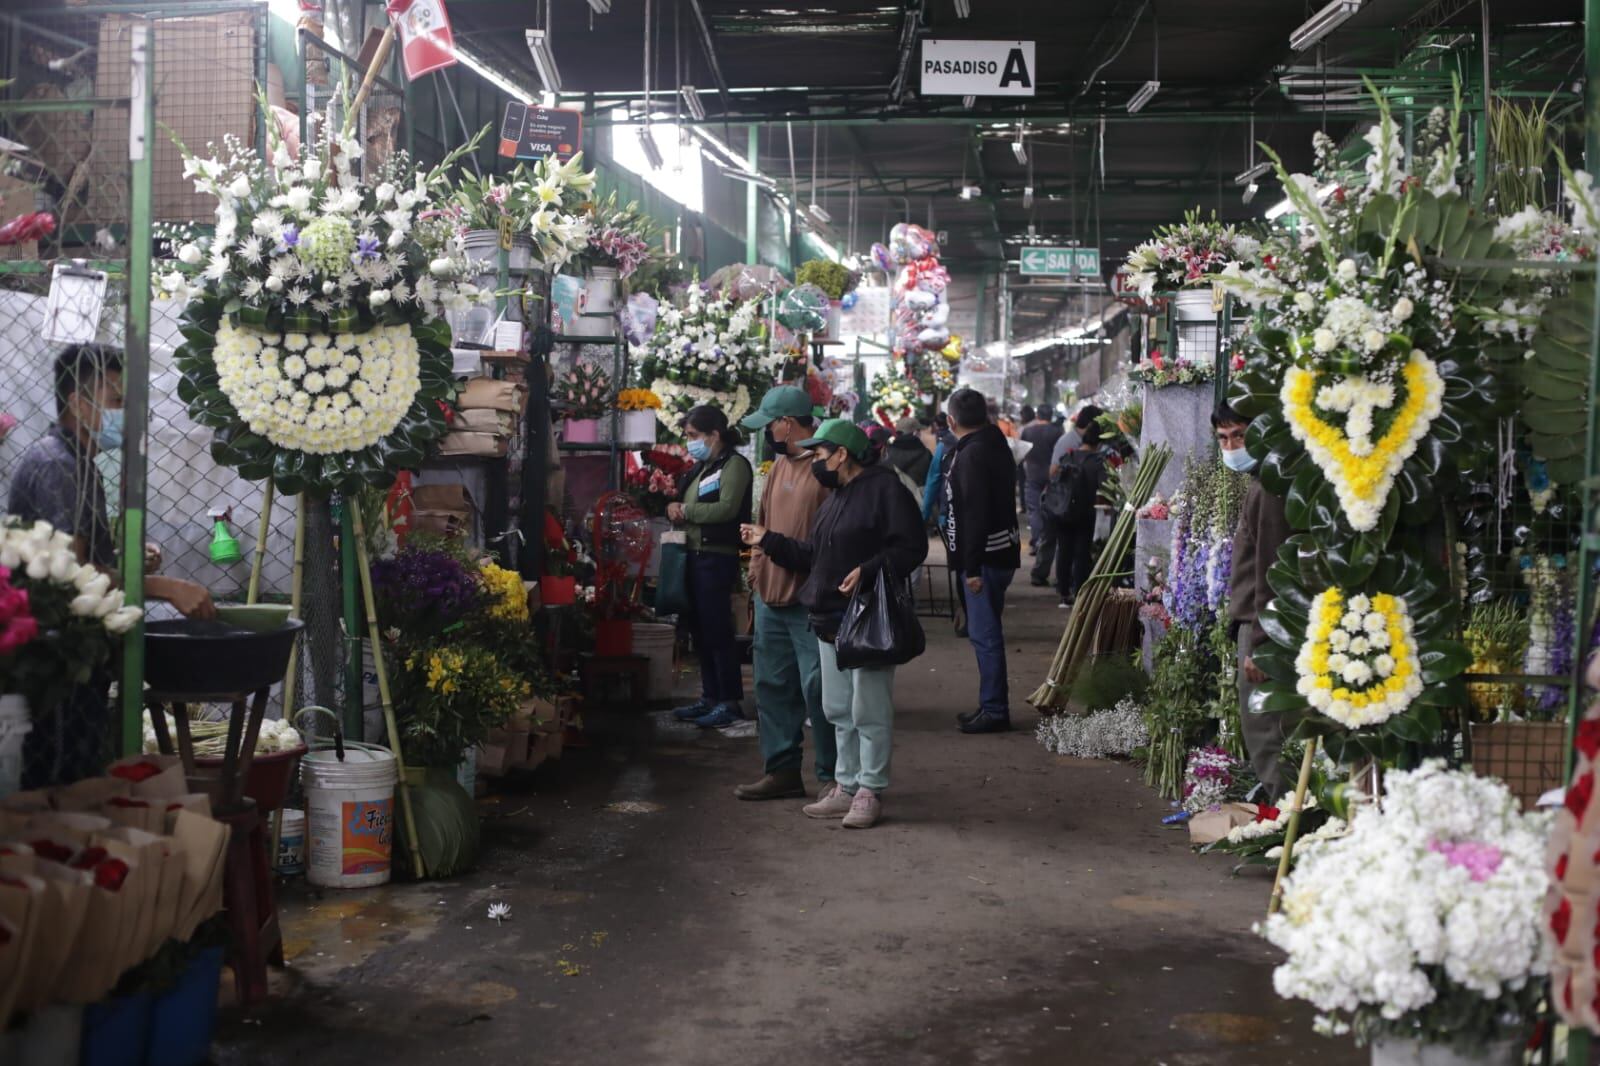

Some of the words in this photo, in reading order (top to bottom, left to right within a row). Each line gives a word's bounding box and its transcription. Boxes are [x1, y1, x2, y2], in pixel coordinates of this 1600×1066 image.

[925, 60, 998, 74] PASADISO
[999, 48, 1032, 88] A
[530, 142, 552, 152] VISA
[1048, 253, 1097, 270] SALIDA
[946, 503, 957, 552] adidas
